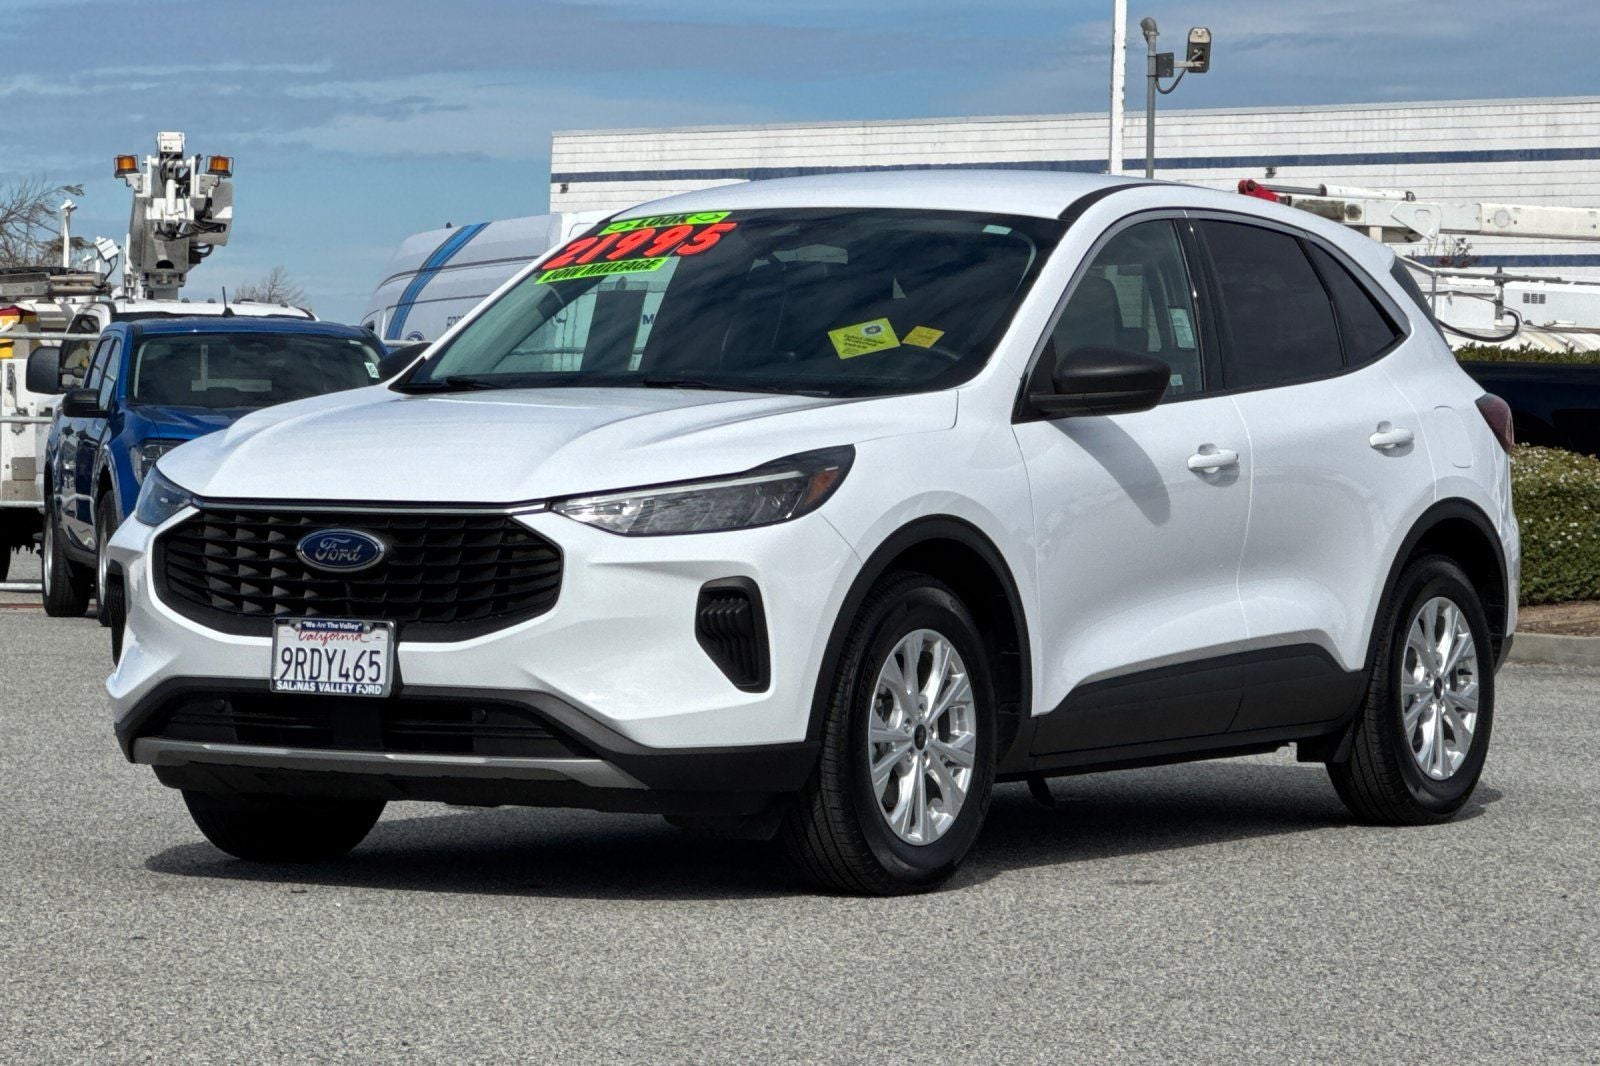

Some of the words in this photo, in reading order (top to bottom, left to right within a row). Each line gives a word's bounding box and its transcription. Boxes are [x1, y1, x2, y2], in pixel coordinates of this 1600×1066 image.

[635, 213, 690, 228] LOOK
[541, 222, 738, 271] 21995
[542, 265, 590, 281] LOW
[580, 258, 662, 277] MILEAGE
[315, 537, 362, 561] Ford
[327, 622, 339, 630] The
[298, 631, 370, 647] California
[281, 647, 381, 682] 9RDY465
[276, 680, 316, 693] SALINAS
[319, 682, 353, 694] VALLEY
[356, 684, 382, 695] FORD
